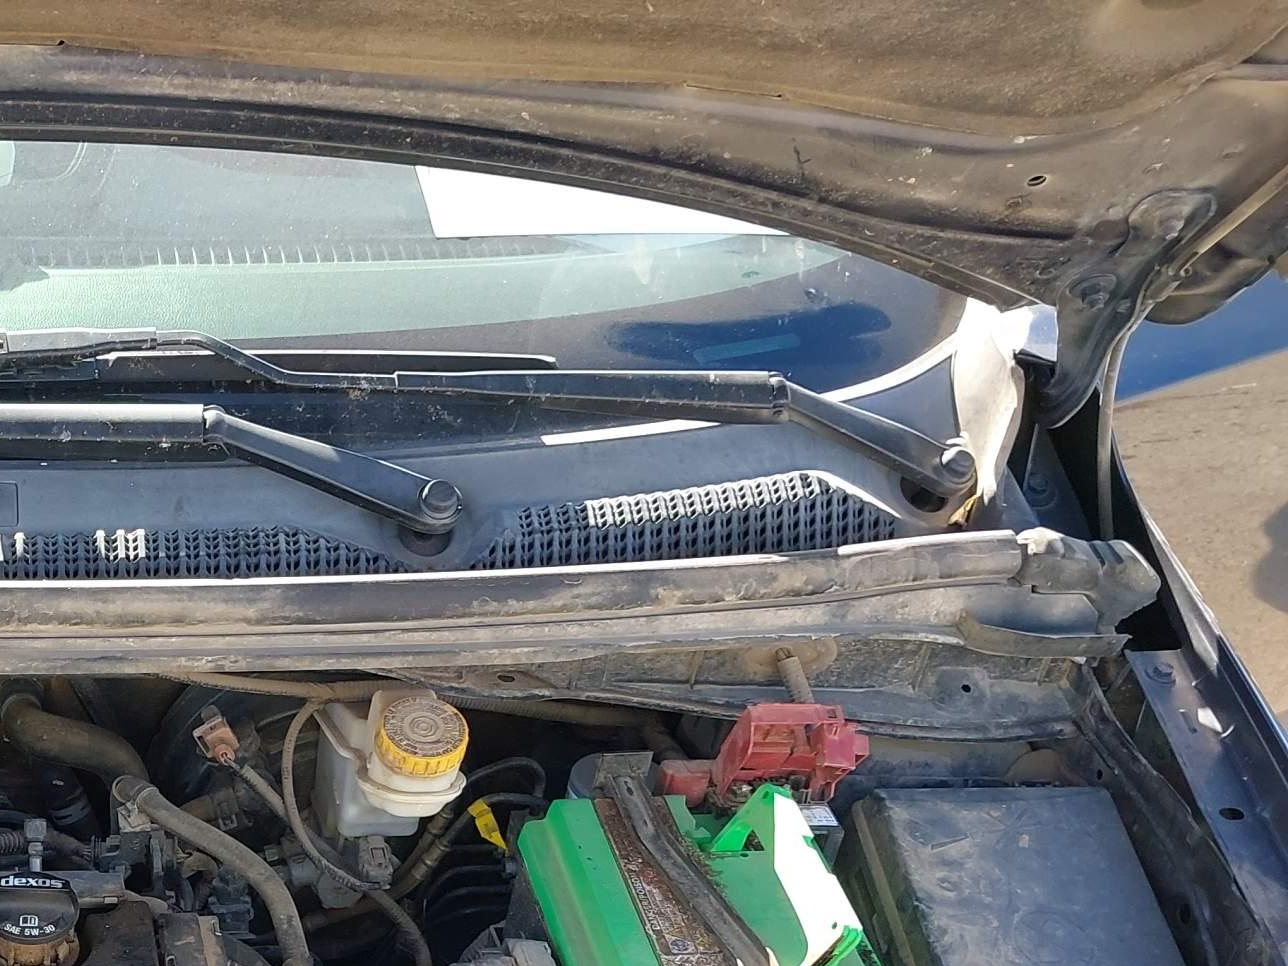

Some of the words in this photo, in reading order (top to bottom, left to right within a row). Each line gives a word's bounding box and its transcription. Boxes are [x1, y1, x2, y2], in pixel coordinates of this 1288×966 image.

[0, 875, 65, 889] dexos
[3, 923, 22, 935] SAE
[24, 924, 56, 936] 5W-30
